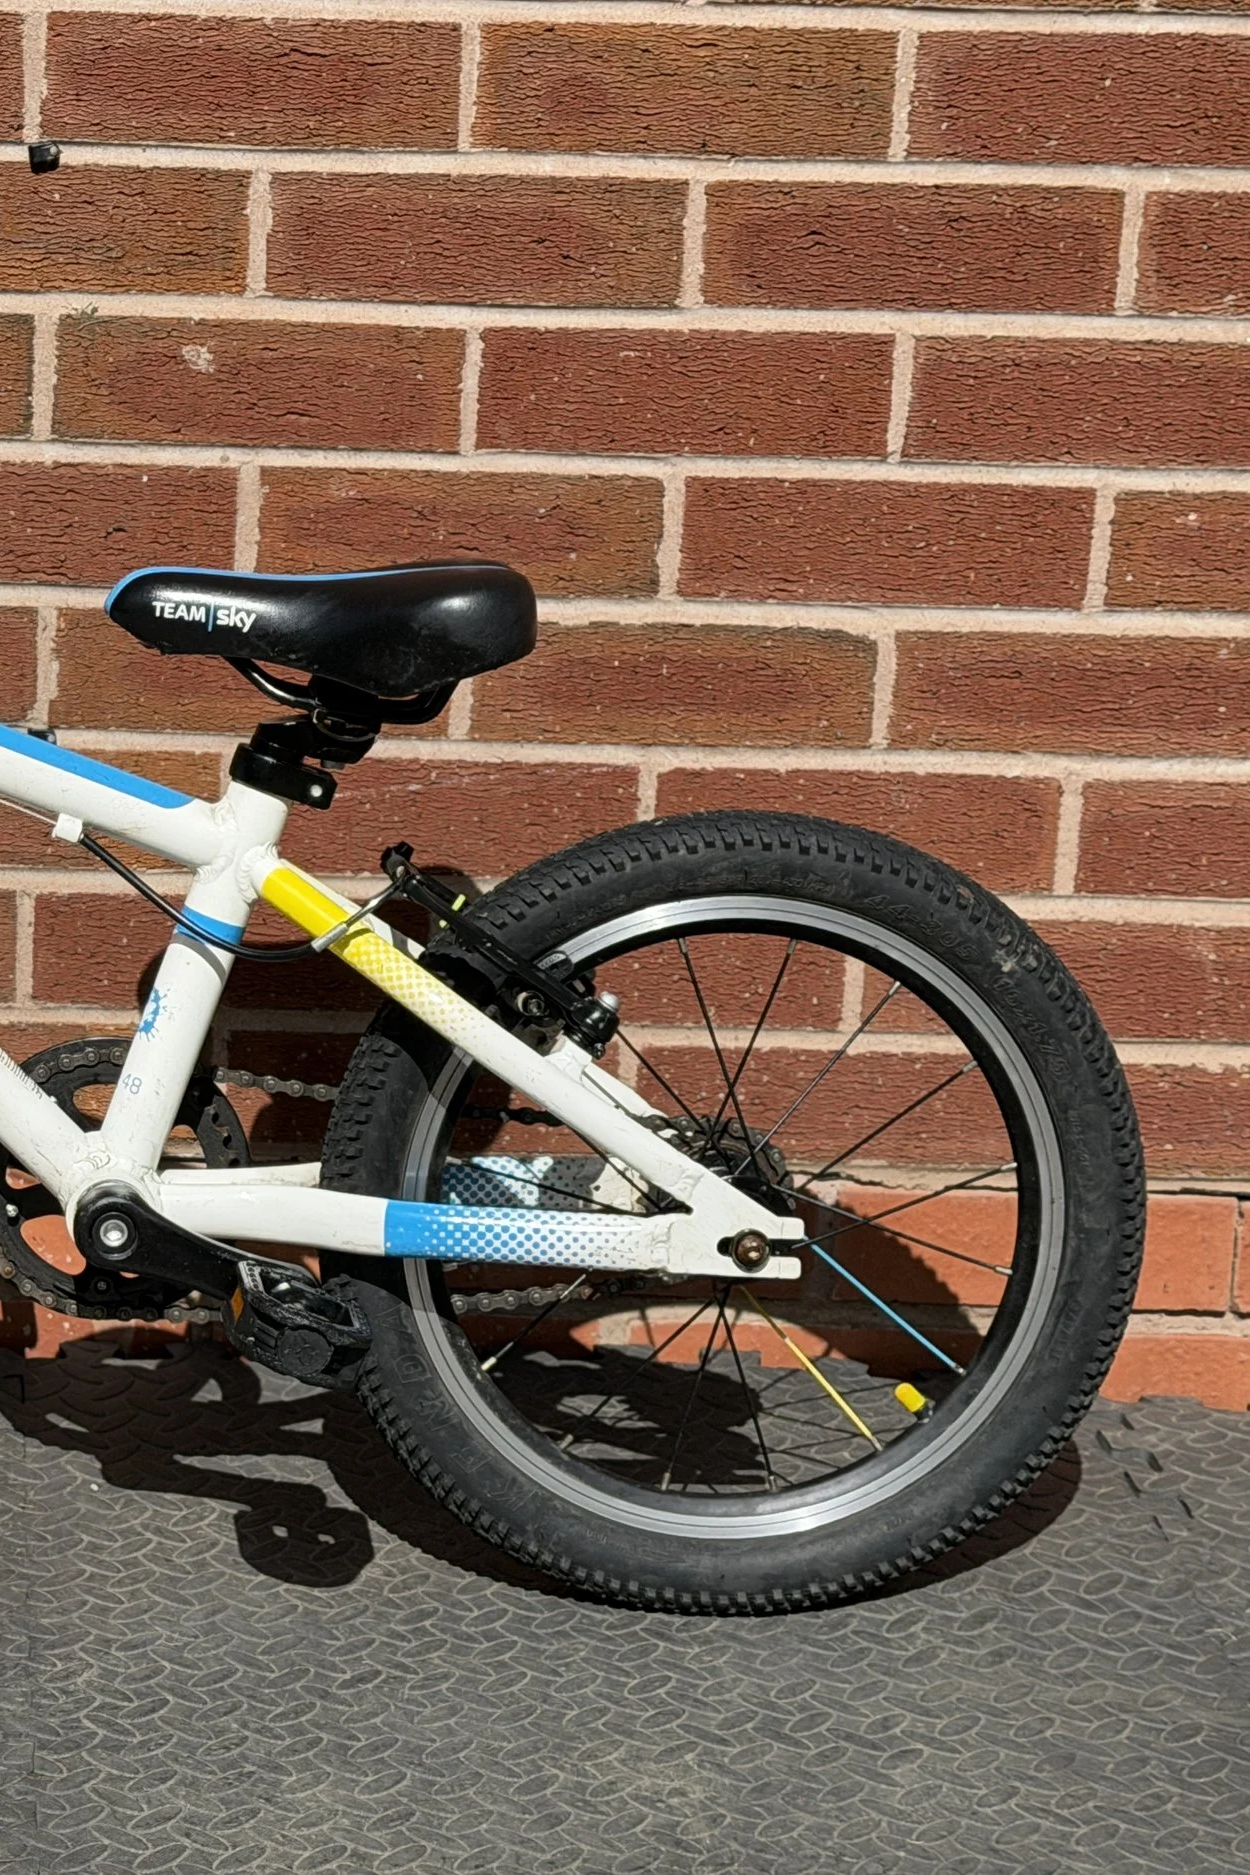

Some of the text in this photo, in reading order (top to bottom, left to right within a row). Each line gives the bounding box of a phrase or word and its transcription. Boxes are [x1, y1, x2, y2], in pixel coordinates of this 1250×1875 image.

[151, 601, 257, 633] TEAM sky
[121, 1072, 143, 1096] 48
[375, 1302, 538, 1514] KENDA
